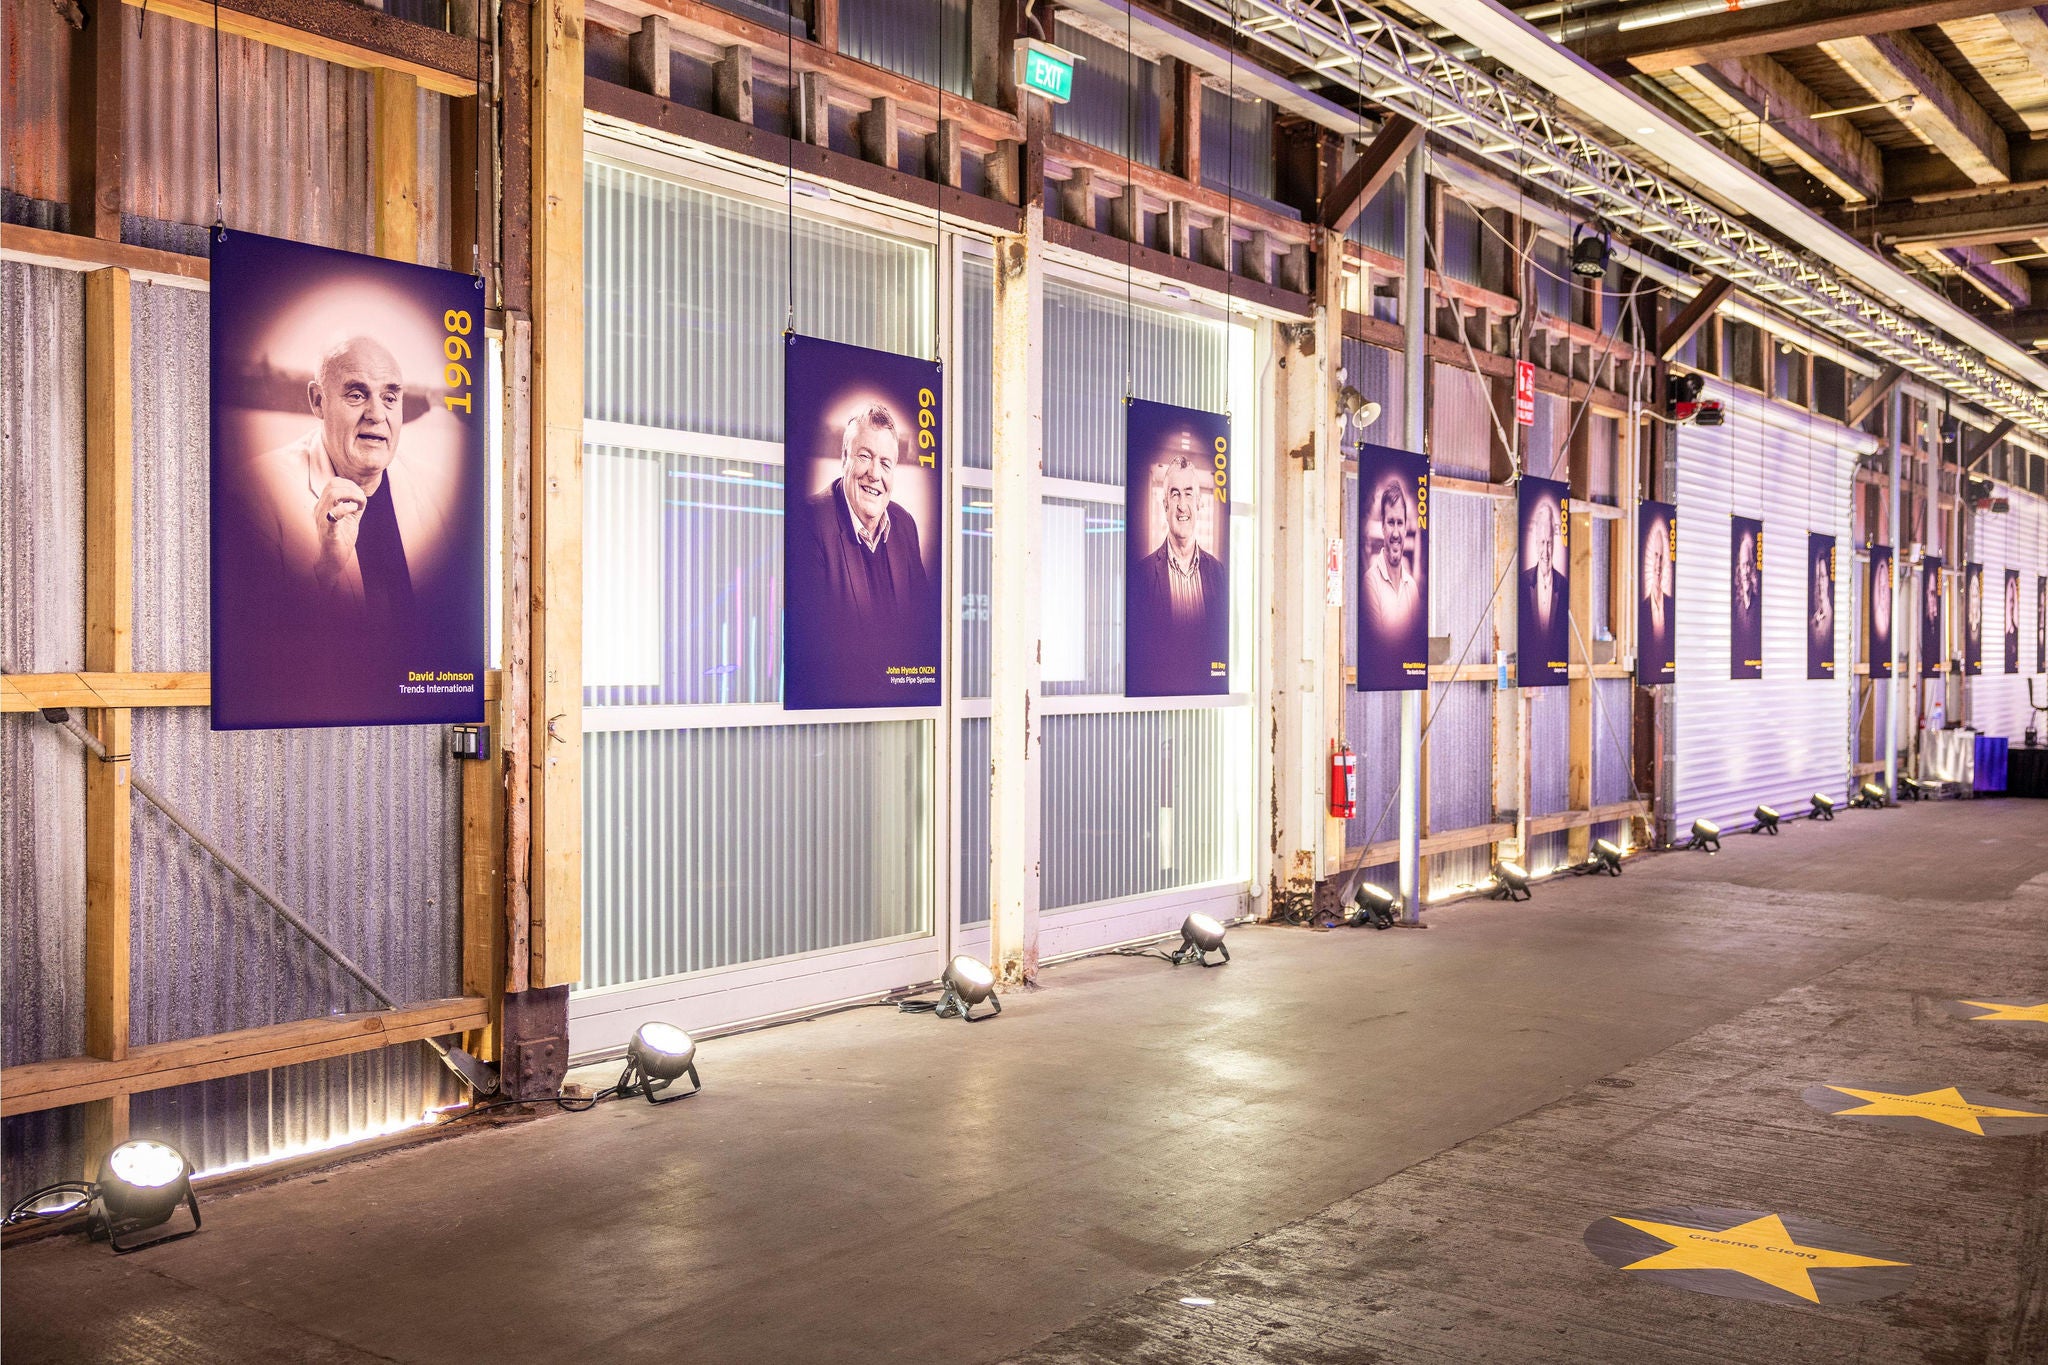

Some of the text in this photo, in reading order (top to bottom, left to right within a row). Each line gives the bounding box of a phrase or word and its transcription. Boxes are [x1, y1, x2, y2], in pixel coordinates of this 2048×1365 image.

[1036, 59, 1064, 92] EXIT
[444, 309, 472, 414] 1998
[919, 388, 936, 469] 1999
[1214, 436, 1227, 504] 2000
[1417, 474, 1427, 530] 2001
[408, 671, 474, 681] David Johnson
[886, 666, 936, 676] John Hynds ONZM
[399, 683, 474, 694] Trends International
[1881, 1096, 1936, 1106] Hannah
[1689, 1234, 1817, 1259] Graeme Clegg
